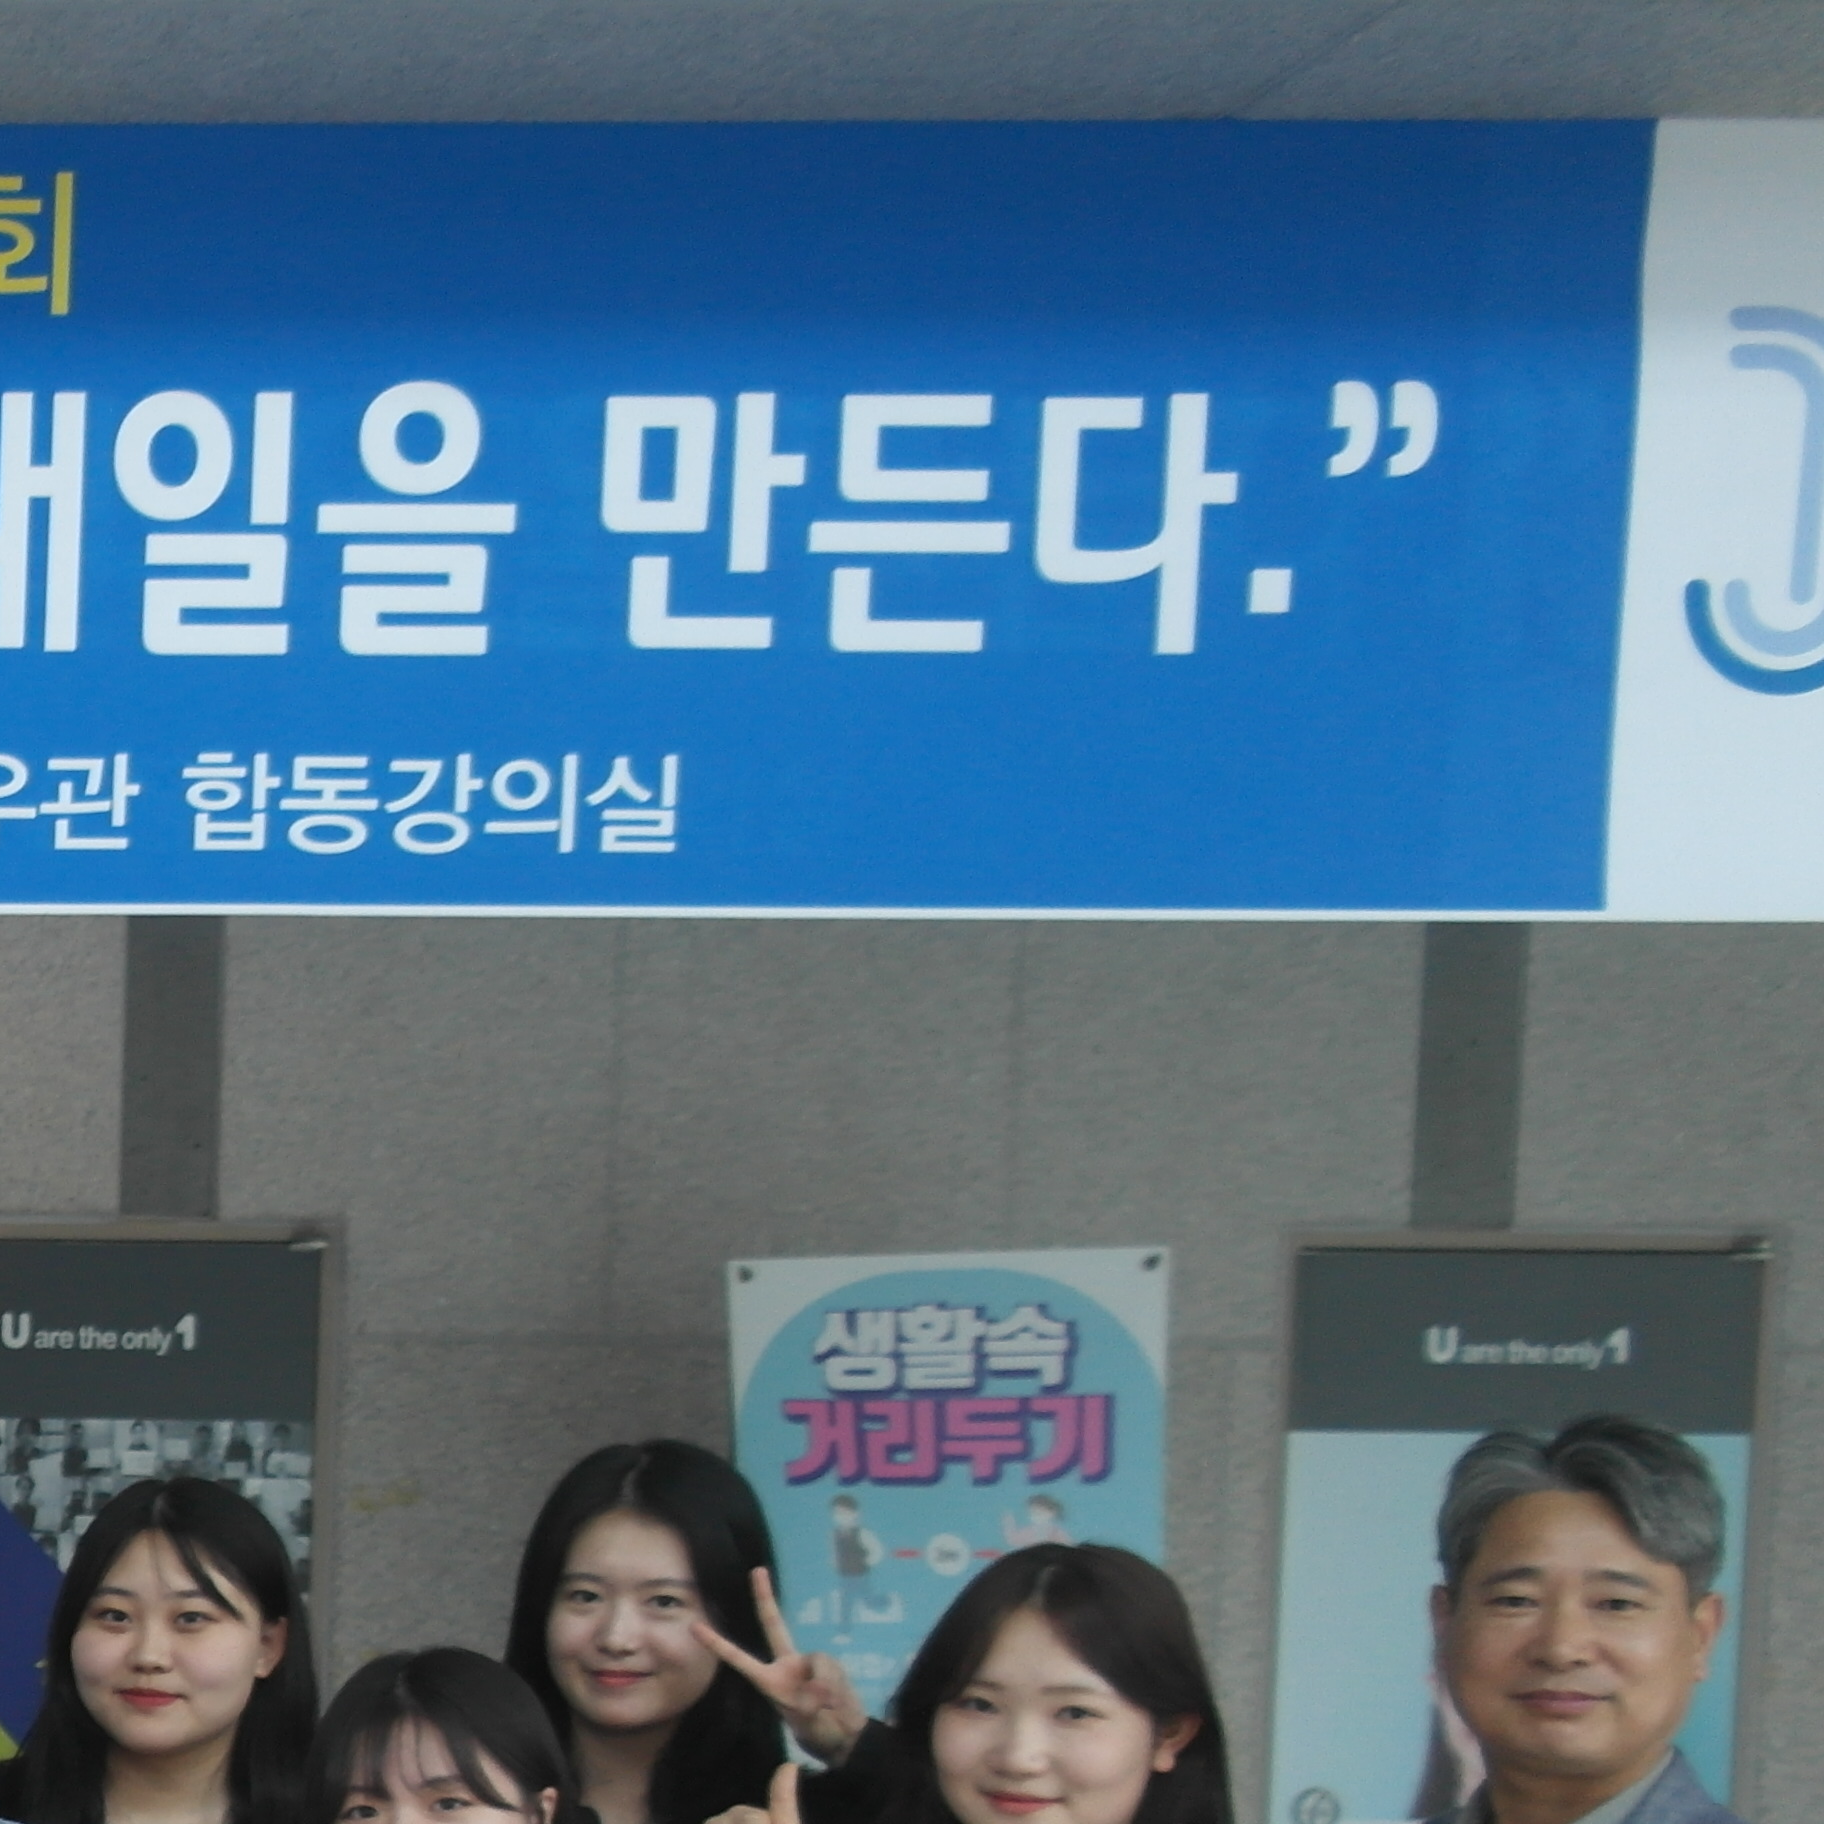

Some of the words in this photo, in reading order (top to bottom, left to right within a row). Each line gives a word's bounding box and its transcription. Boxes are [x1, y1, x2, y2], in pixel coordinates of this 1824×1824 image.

[183, 753, 678, 854] 합동강의실
[1, 1312, 31, 1349] U
[34, 1330, 75, 1349] are
[78, 1326, 118, 1350] the
[121, 1326, 173, 1356] only
[174, 1313, 198, 1350] 1
[814, 1302, 1075, 1394] 생활속
[1426, 1327, 1459, 1364] U
[1462, 1344, 1505, 1364] are
[1507, 1340, 1549, 1365] the
[1552, 1340, 1604, 1370] only
[783, 1393, 1114, 1484] 거리두기
